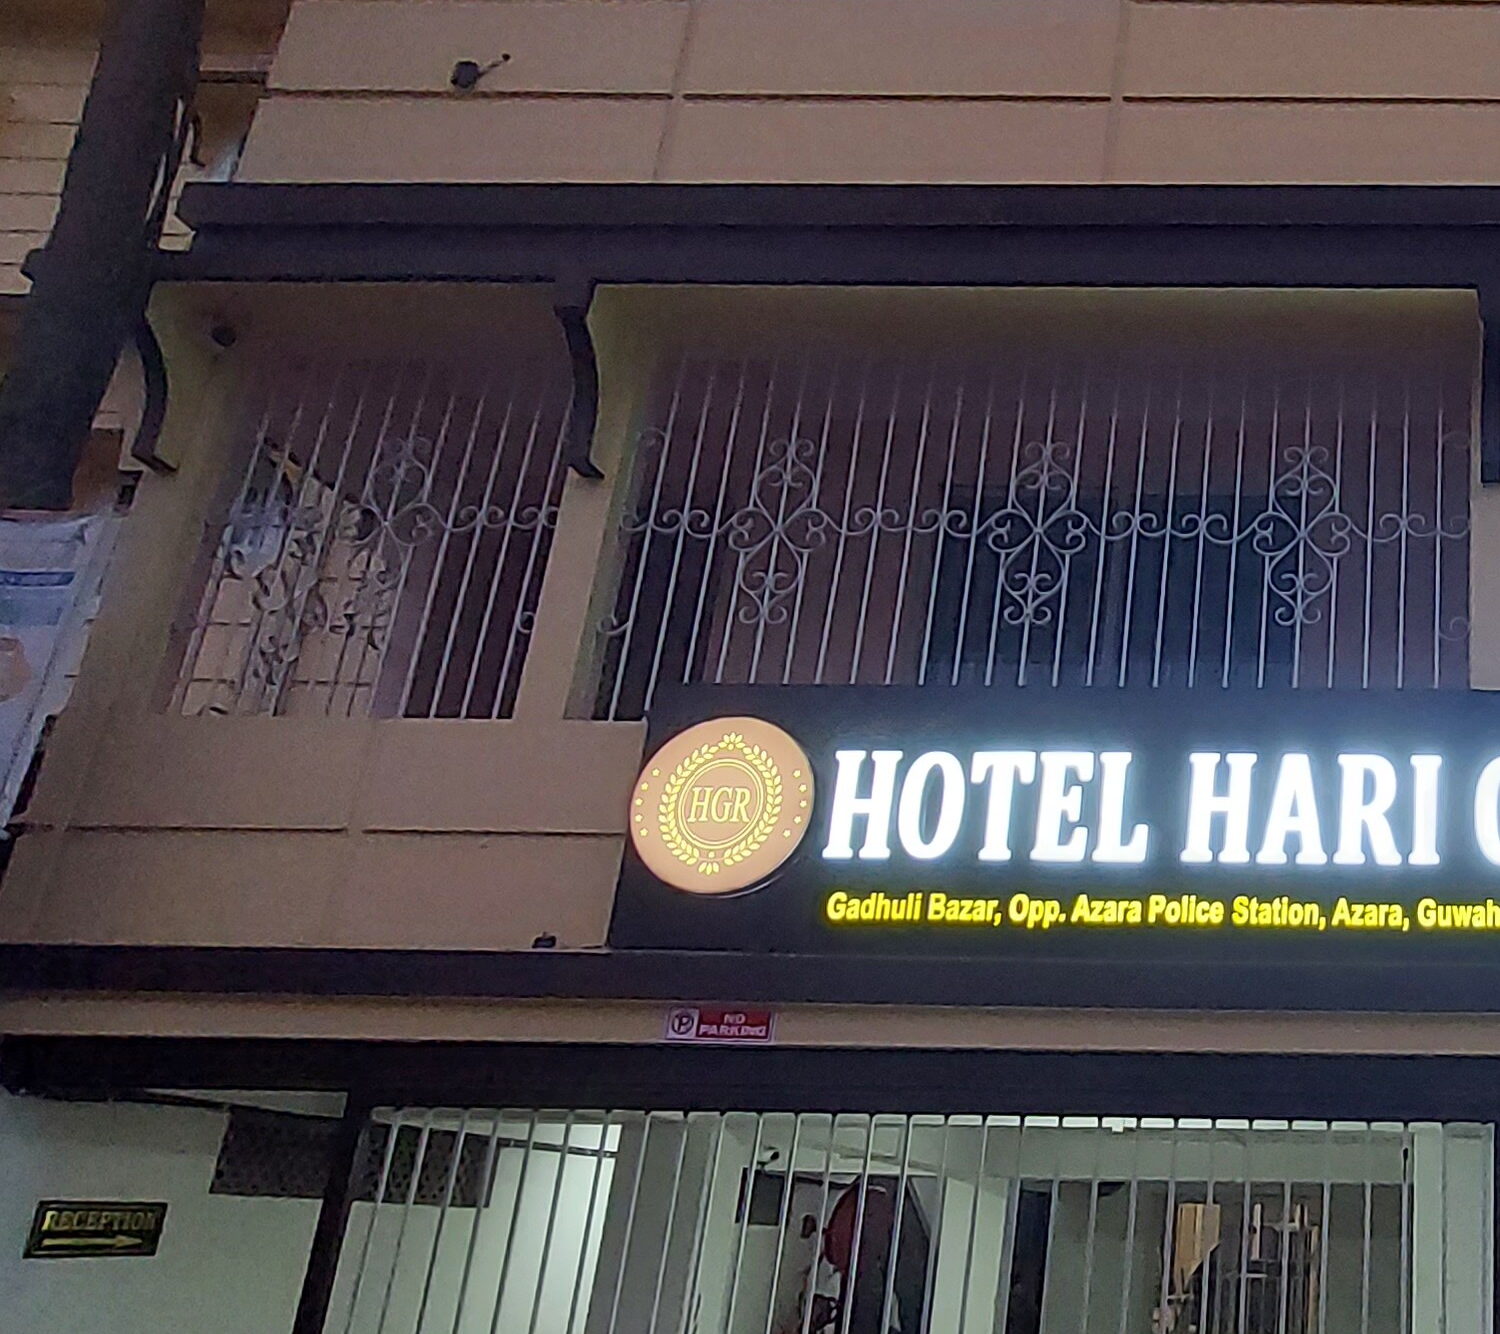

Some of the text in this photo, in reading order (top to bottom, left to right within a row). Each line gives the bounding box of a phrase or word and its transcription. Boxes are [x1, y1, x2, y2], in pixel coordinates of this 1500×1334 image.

[687, 786, 751, 823] HGR
[821, 749, 1149, 863] HOTEL
[1180, 752, 1443, 867] HARI
[827, 891, 923, 921] Gadhuli
[928, 893, 1001, 926] Bazar,
[1008, 893, 1066, 929] Opp.
[1070, 894, 1142, 923] Azara
[1147, 894, 1224, 924] Police
[1231, 895, 1327, 930] Station,
[1331, 897, 1410, 932] Azara,
[698, 1023, 767, 1037] PARKING
[724, 1013, 746, 1024] NO
[41, 1210, 157, 1232] RECEPTION
